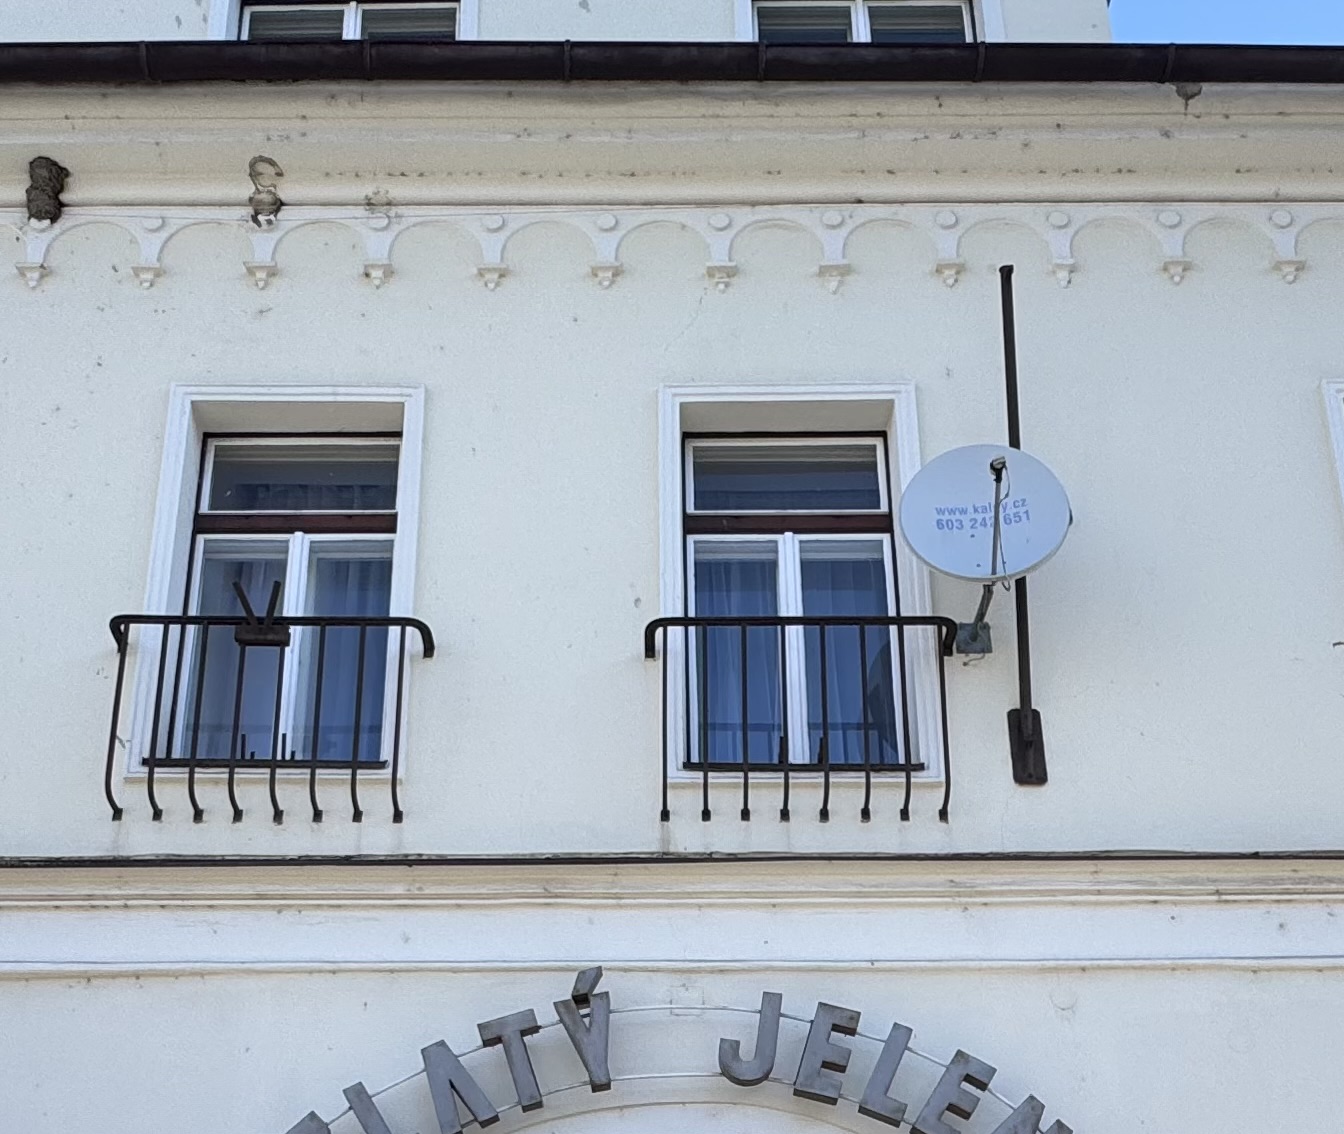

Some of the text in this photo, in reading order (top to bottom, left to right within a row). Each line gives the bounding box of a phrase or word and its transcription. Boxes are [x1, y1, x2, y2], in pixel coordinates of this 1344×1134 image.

[935, 498, 1028, 517] www.kaly.cz
[936, 518, 964, 531] 603
[1003, 509, 1031, 526] 651
